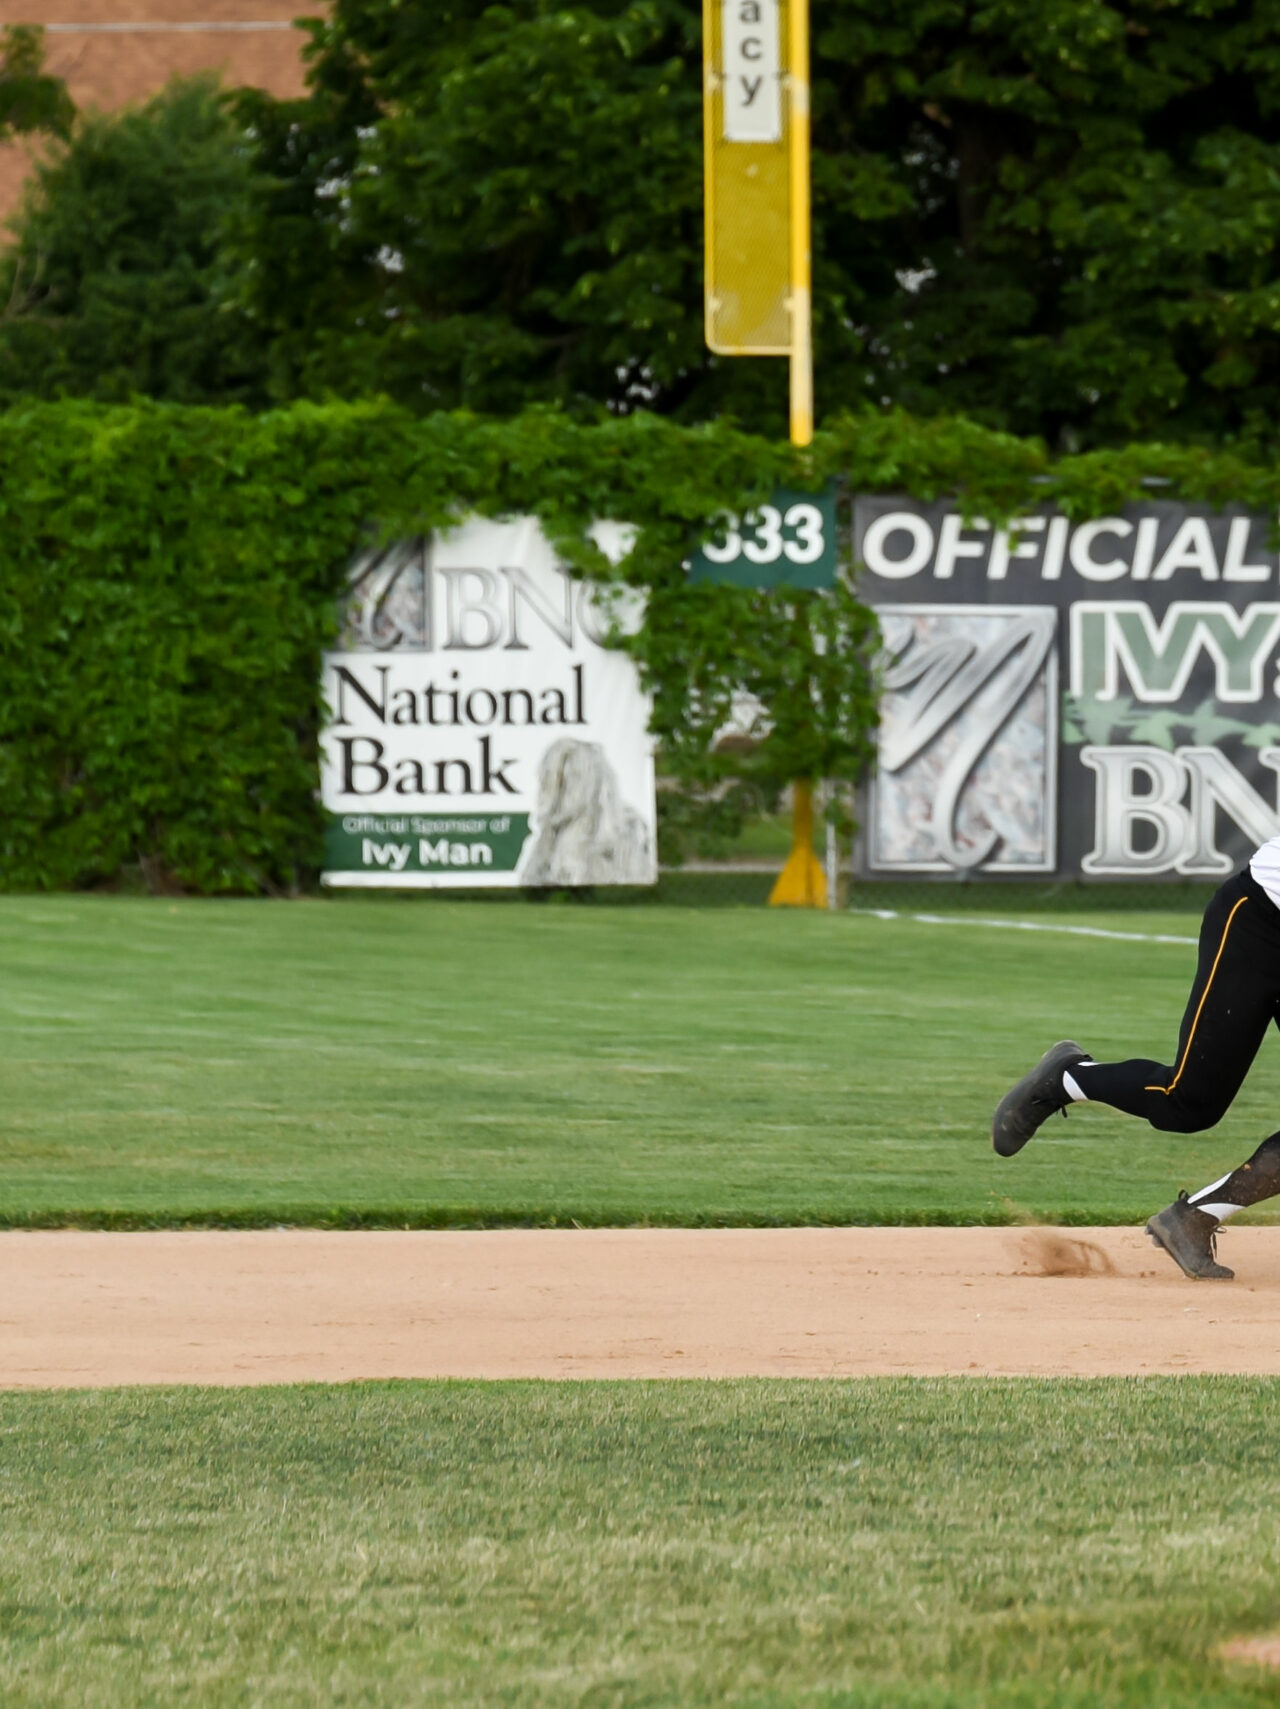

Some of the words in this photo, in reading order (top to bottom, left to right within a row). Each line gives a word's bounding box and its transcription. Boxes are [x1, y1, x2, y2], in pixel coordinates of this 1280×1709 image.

[702, 503, 824, 564] 333
[862, 511, 1271, 582] OFFICIAL
[331, 664, 588, 726] National
[335, 735, 521, 796] Bank
[342, 815, 409, 834] Official
[411, 815, 487, 837] Sponsor
[489, 815, 511, 834] of
[361, 838, 412, 871] Ivy
[418, 838, 493, 867] Man
